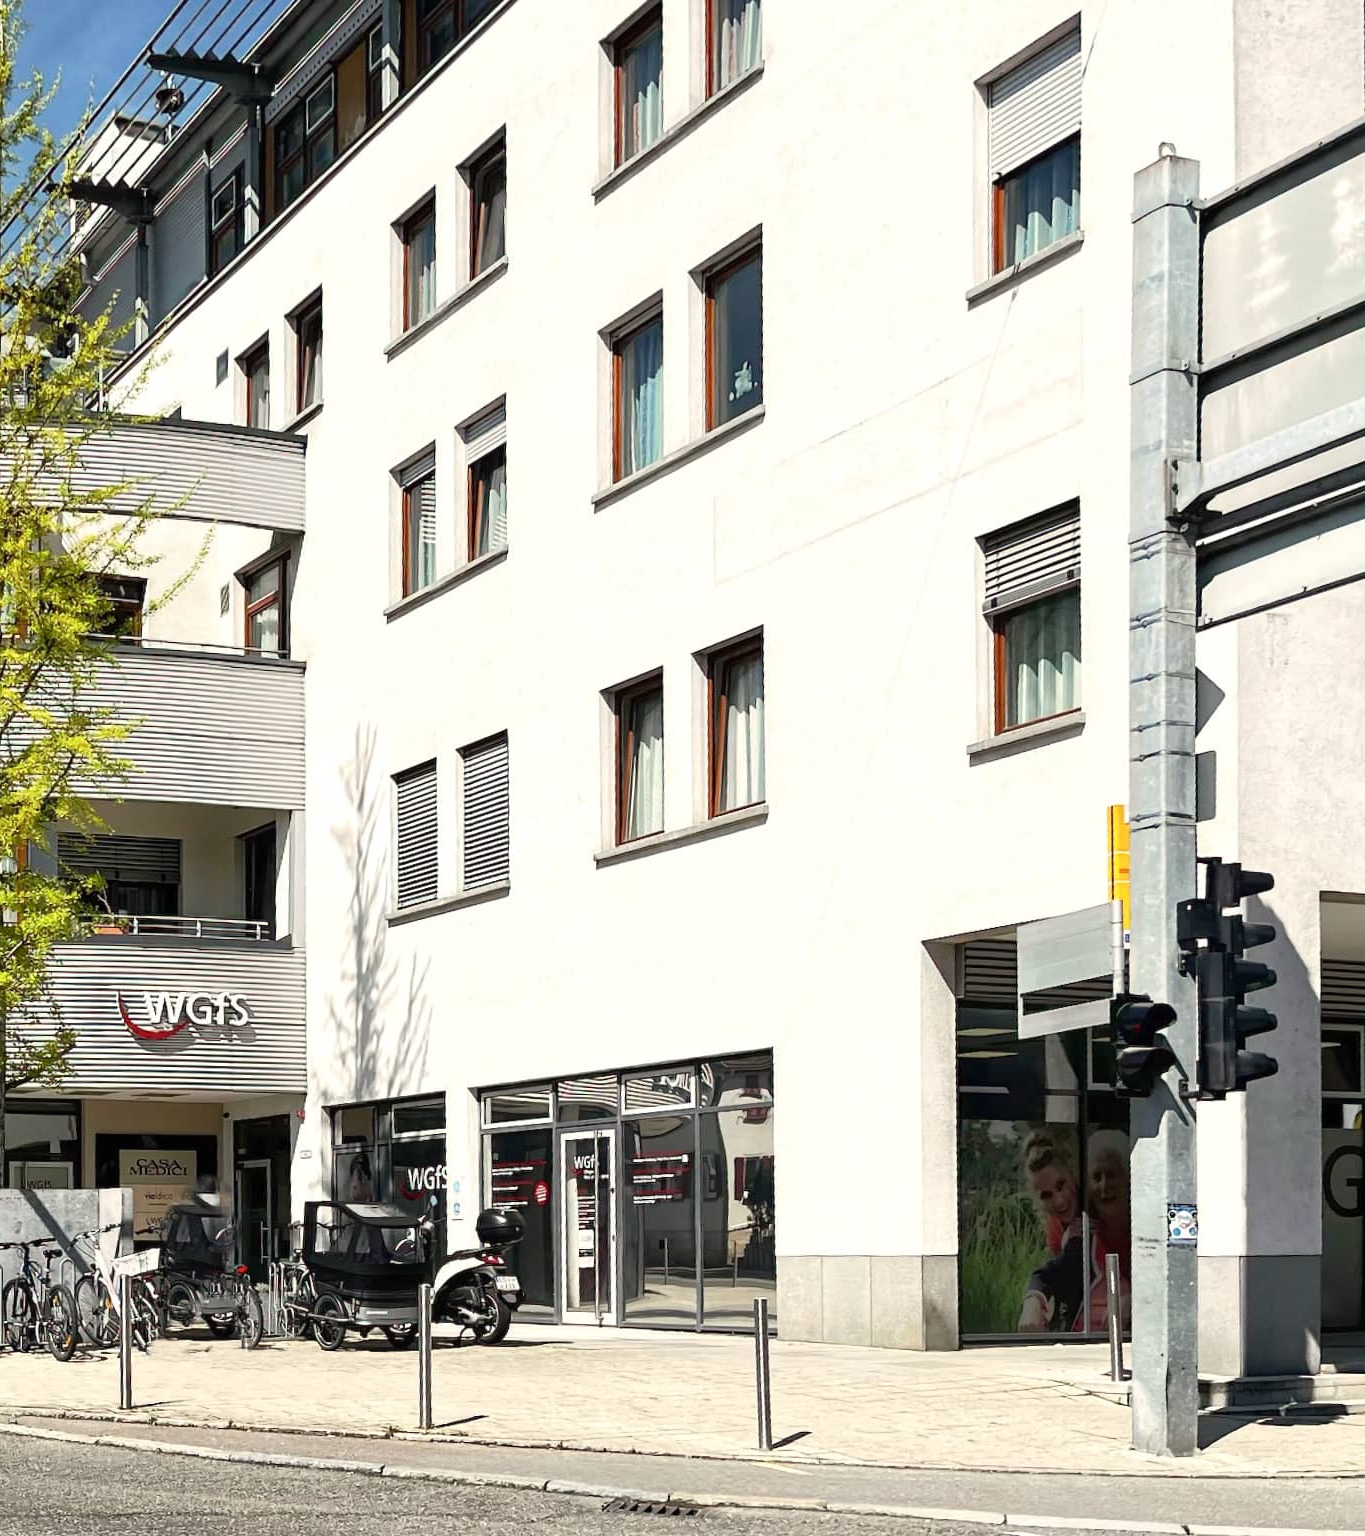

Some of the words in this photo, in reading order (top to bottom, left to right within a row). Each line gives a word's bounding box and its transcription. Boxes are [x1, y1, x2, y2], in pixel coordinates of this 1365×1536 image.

[143, 991, 250, 1027] WGfS
[136, 1158, 181, 1169] CASA
[130, 1166, 187, 1176] MEDICI
